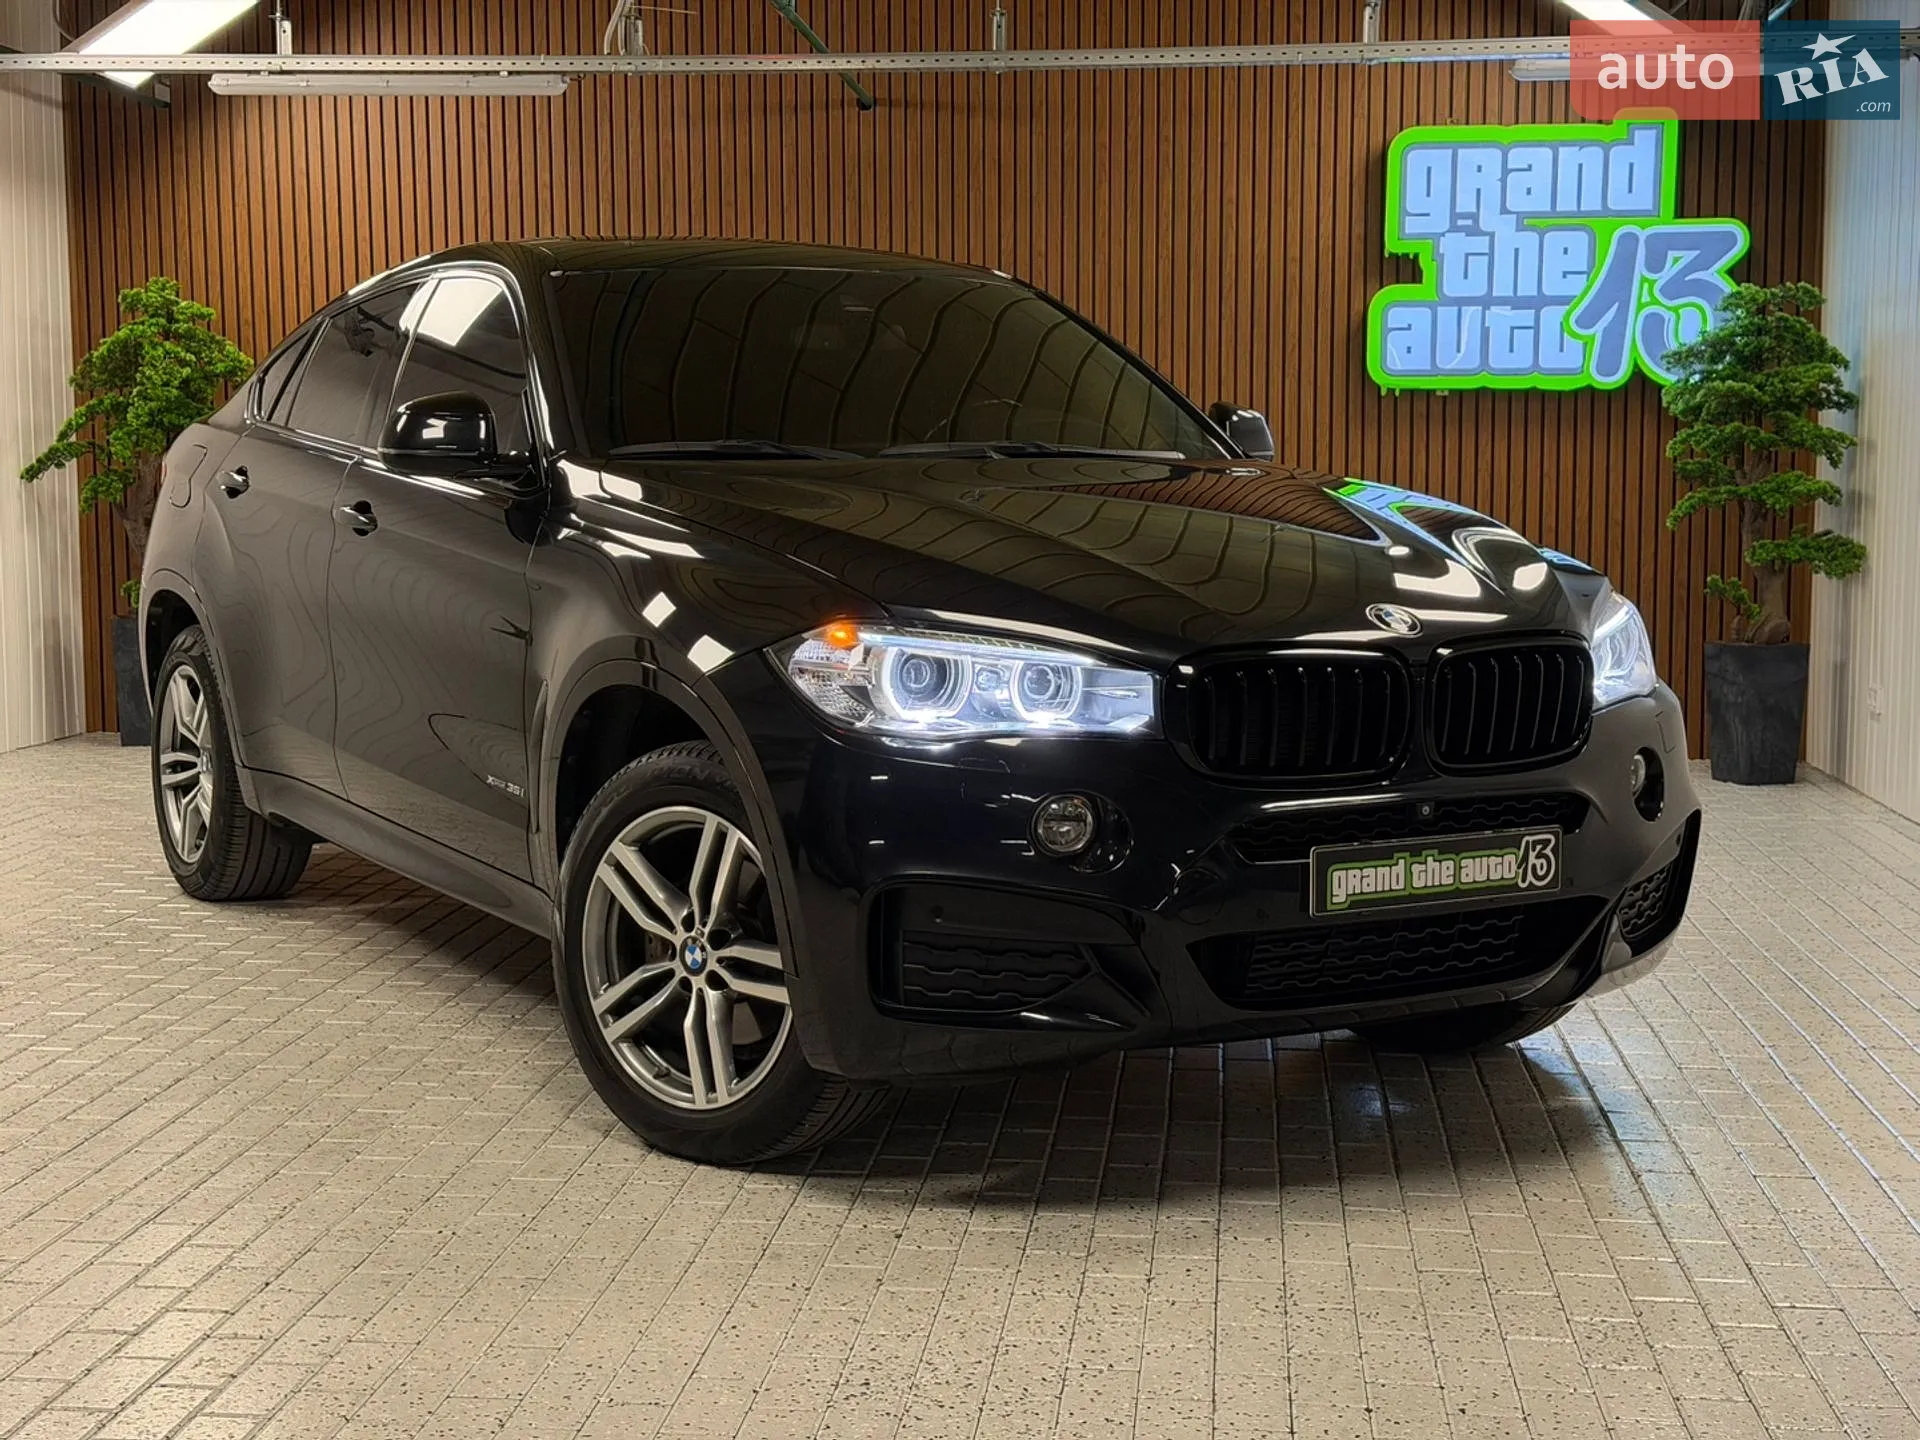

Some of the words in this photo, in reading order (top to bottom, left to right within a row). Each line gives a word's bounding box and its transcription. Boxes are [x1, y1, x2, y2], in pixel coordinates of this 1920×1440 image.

[1439, 215, 1589, 297] the
[1387, 306, 1585, 370] auto
[1411, 856, 1455, 888] the
[1460, 854, 1516, 883] auto
